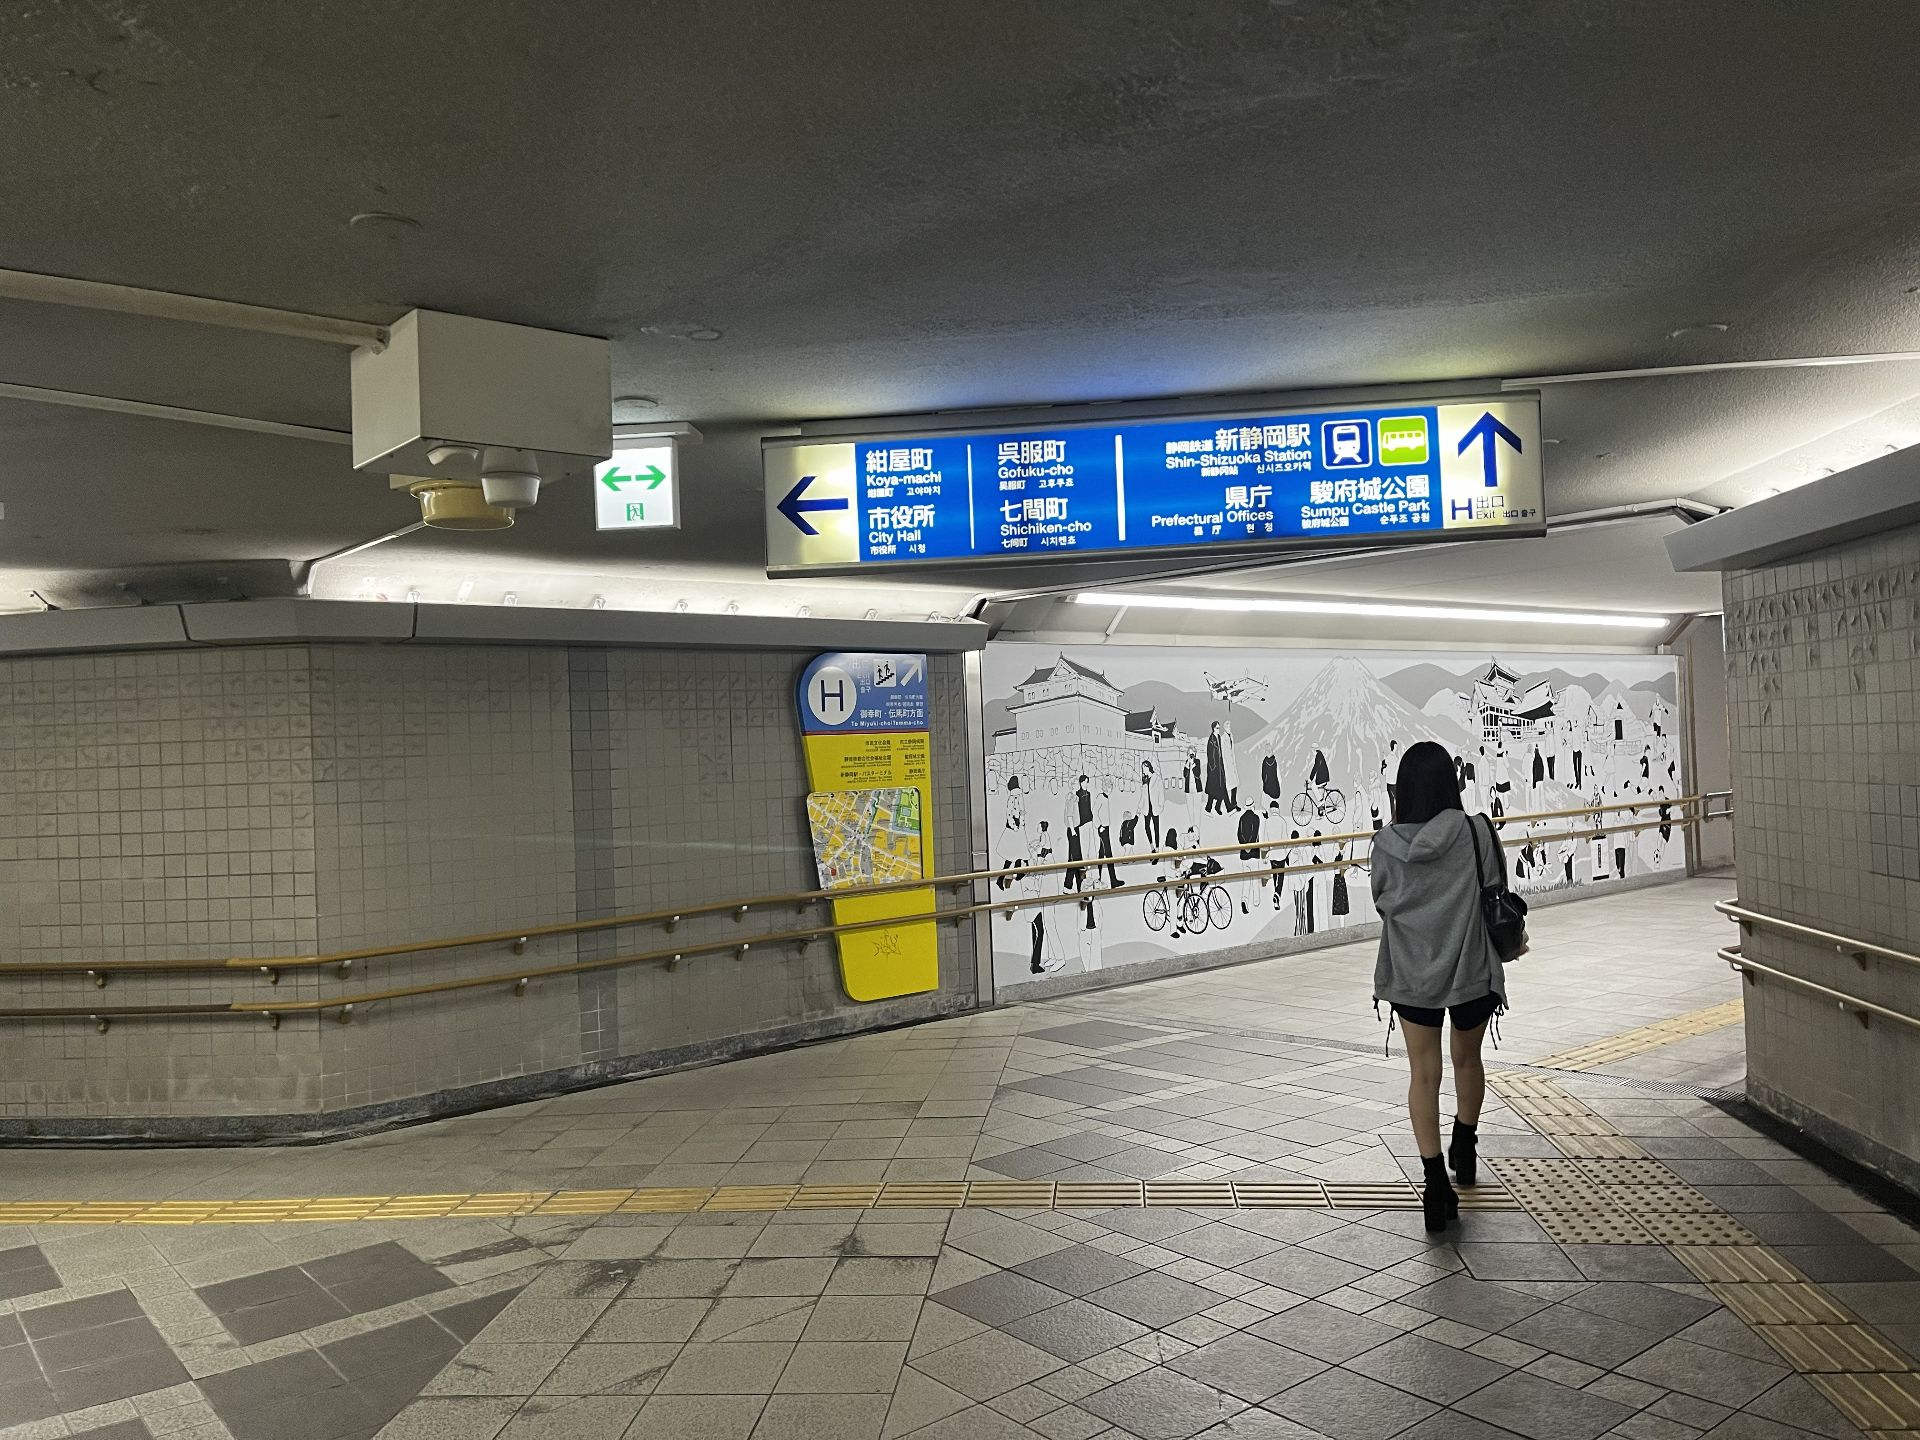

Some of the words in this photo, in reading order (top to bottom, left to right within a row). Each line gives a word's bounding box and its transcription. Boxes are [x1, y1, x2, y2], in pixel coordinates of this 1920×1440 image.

[1215, 423, 1311, 452] 新静岡駅
[866, 448, 934, 473] 紺屋町
[998, 440, 1067, 465] 呉服町
[1165, 452, 1261, 469] Shin-Shizuoka
[1265, 449, 1312, 463] Station
[866, 471, 942, 488] Koya-machi
[998, 464, 1074, 478] Gofuku-cho
[906, 485, 941, 496] 고야마치
[1225, 484, 1273, 510] 県庁
[1310, 474, 1430, 504] 駿府城公園
[999, 497, 1069, 522] 七間町
[1301, 505, 1349, 520] Sumpu
[1352, 502, 1396, 515] Castle
[1398, 499, 1431, 513] Park
[1451, 498, 1473, 521] H
[1476, 496, 1504, 509] 出口
[867, 504, 936, 530] 市役所
[1151, 512, 1224, 527] Prefectural
[1226, 510, 1274, 524] Offices
[1476, 511, 1496, 520] Exit
[868, 531, 894, 545] City
[897, 530, 921, 542] Hall
[1000, 520, 1093, 537] Shichiken-cho
[820, 679, 844, 712] H
